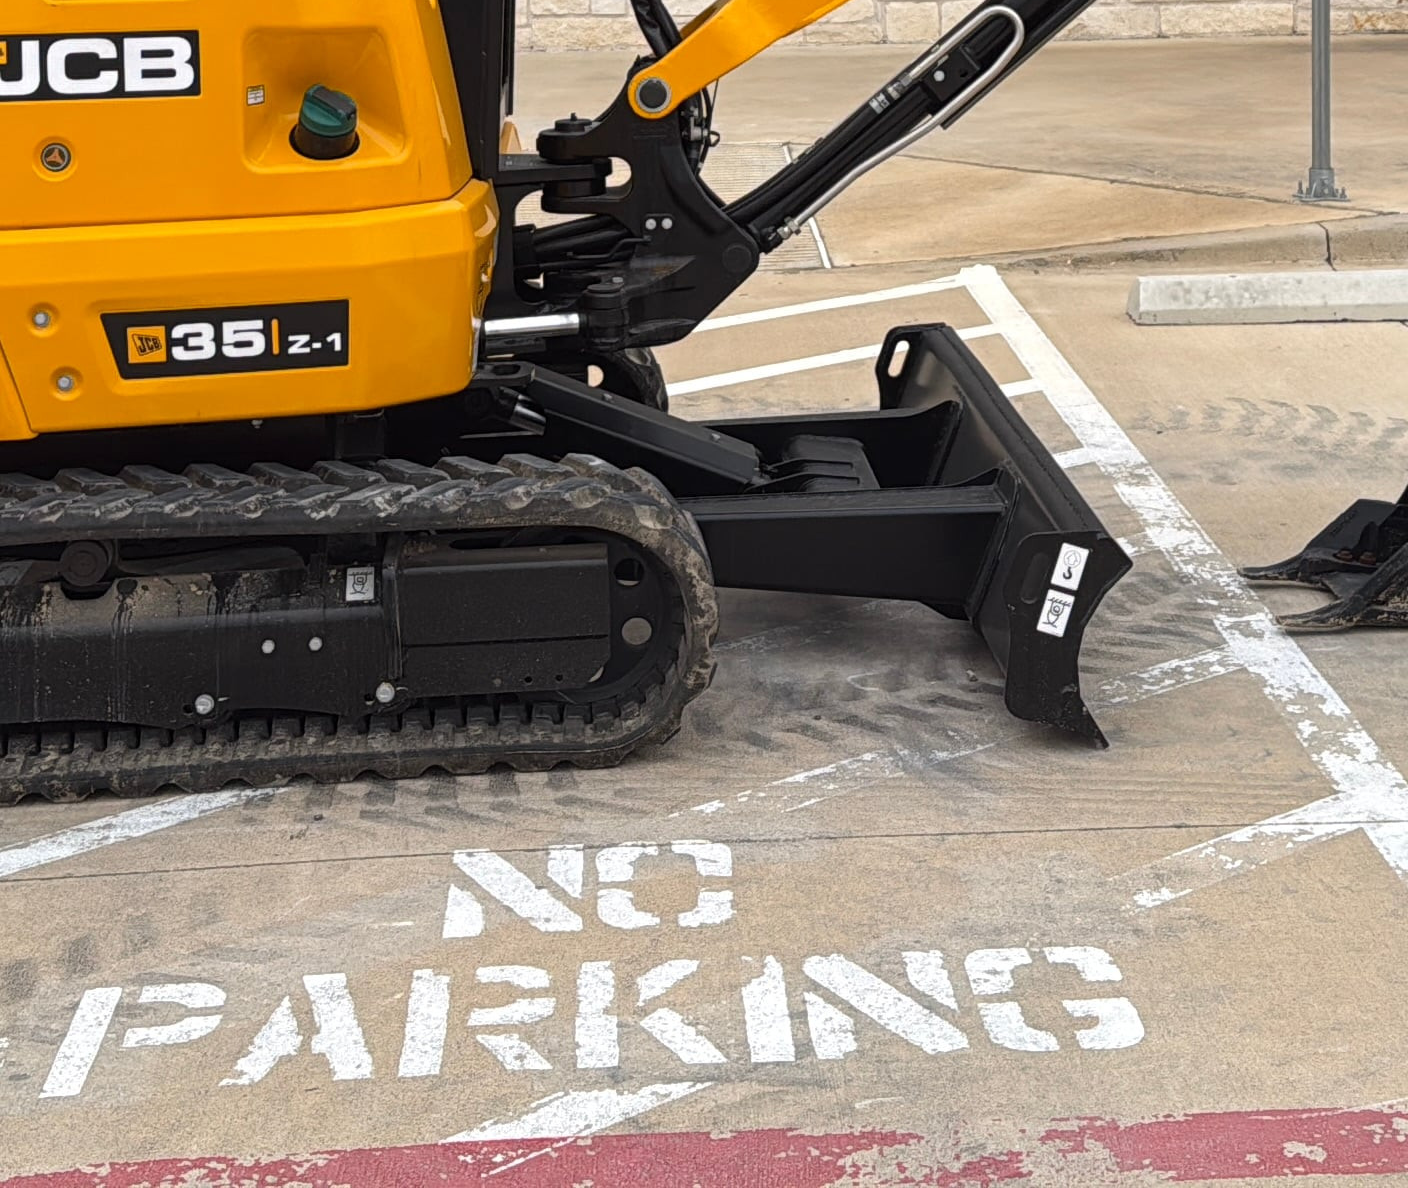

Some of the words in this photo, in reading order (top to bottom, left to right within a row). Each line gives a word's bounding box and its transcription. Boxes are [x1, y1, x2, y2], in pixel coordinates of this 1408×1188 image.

[137, 334, 161, 354] JCB
[171, 319, 266, 361] 35
[442, 839, 735, 939] NO
[38, 945, 1145, 1099] PARKING
